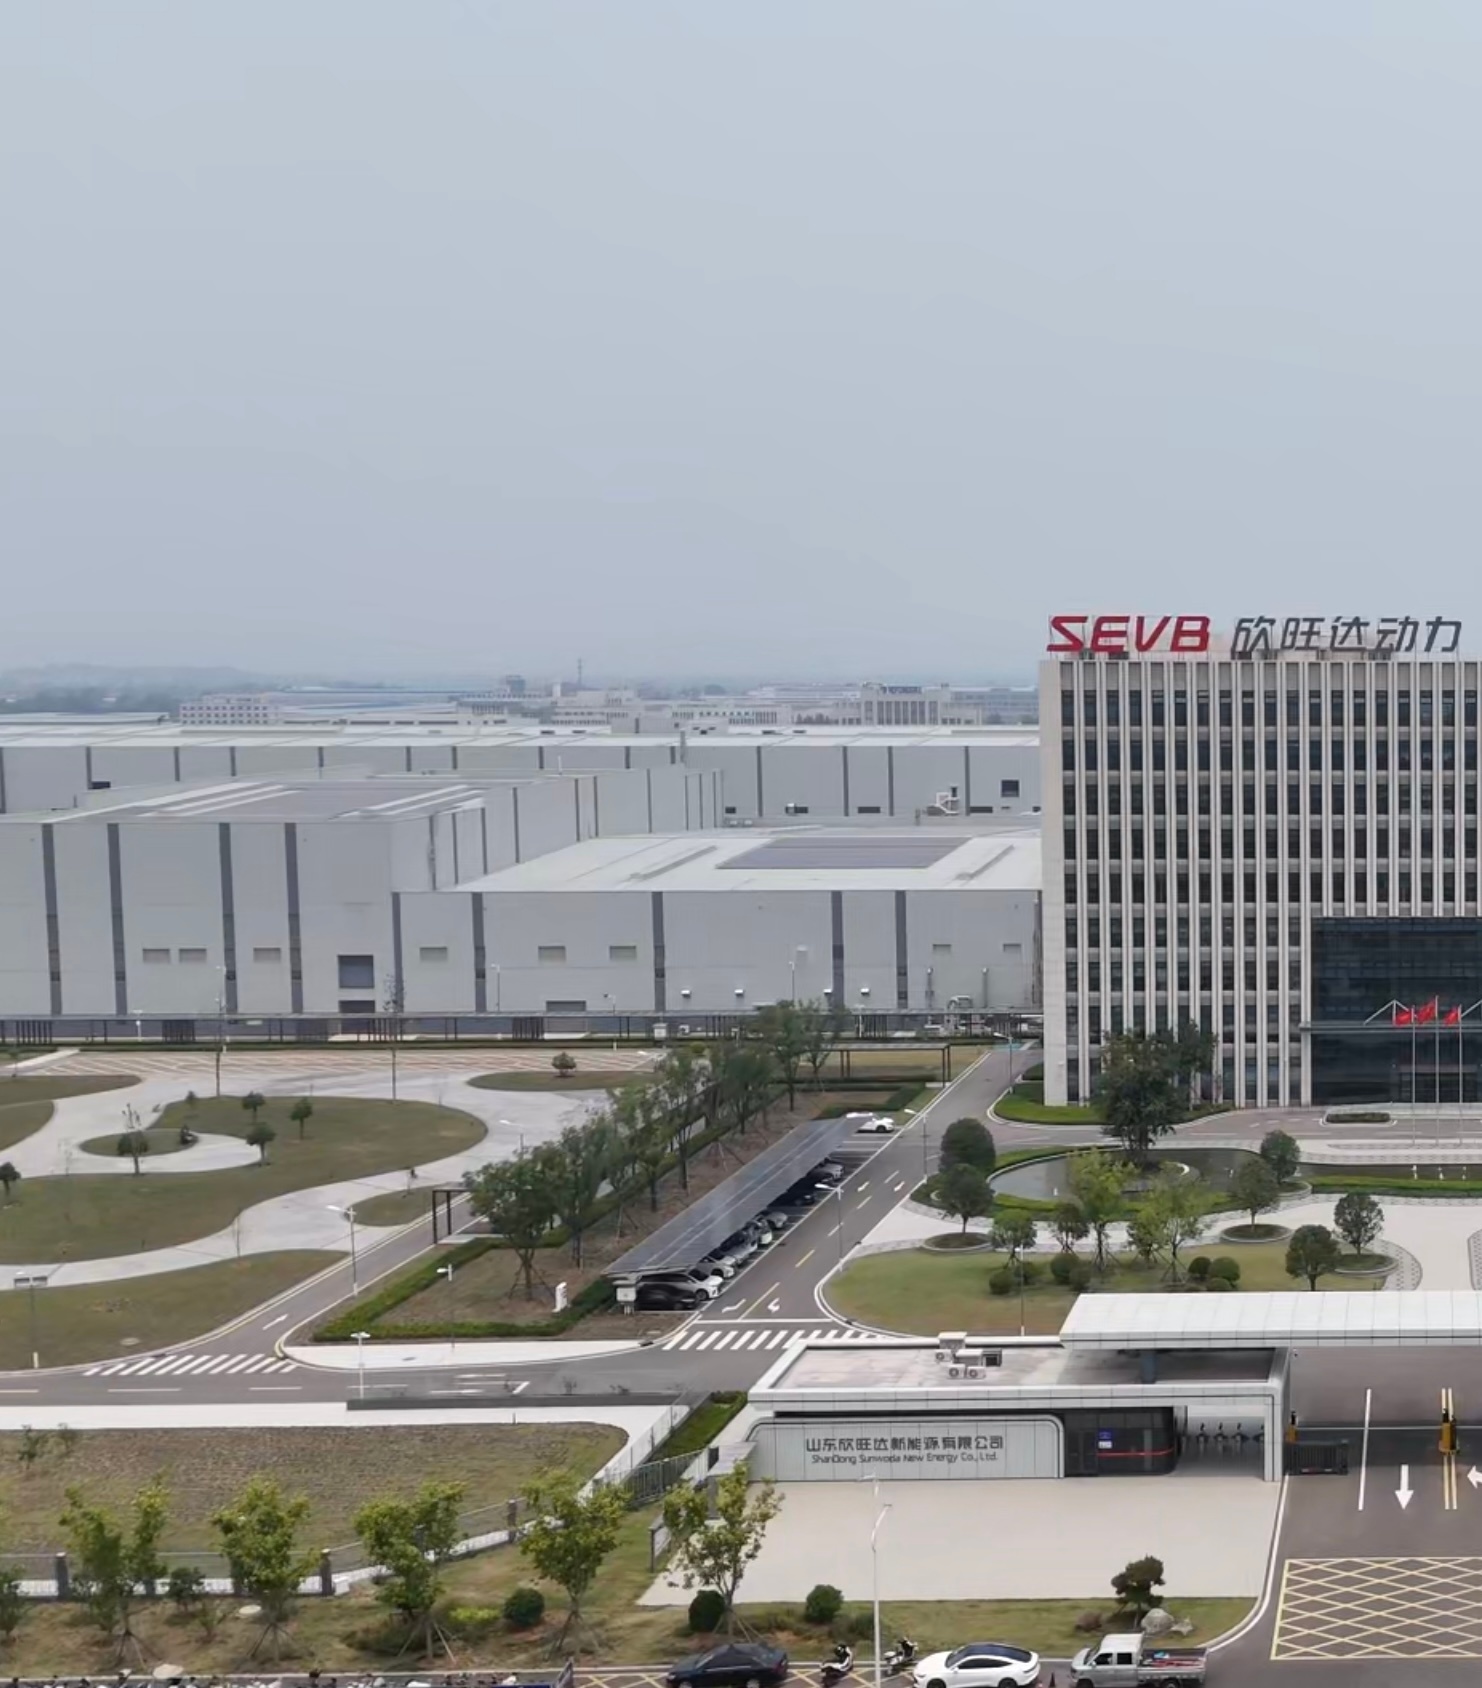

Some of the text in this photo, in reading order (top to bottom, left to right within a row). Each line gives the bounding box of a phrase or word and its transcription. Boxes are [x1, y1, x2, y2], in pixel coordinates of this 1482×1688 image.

[1047, 616, 1462, 653] SEVB 欣旺达动力
[903, 1454, 924, 1462] New
[926, 1453, 958, 1463] Energy
